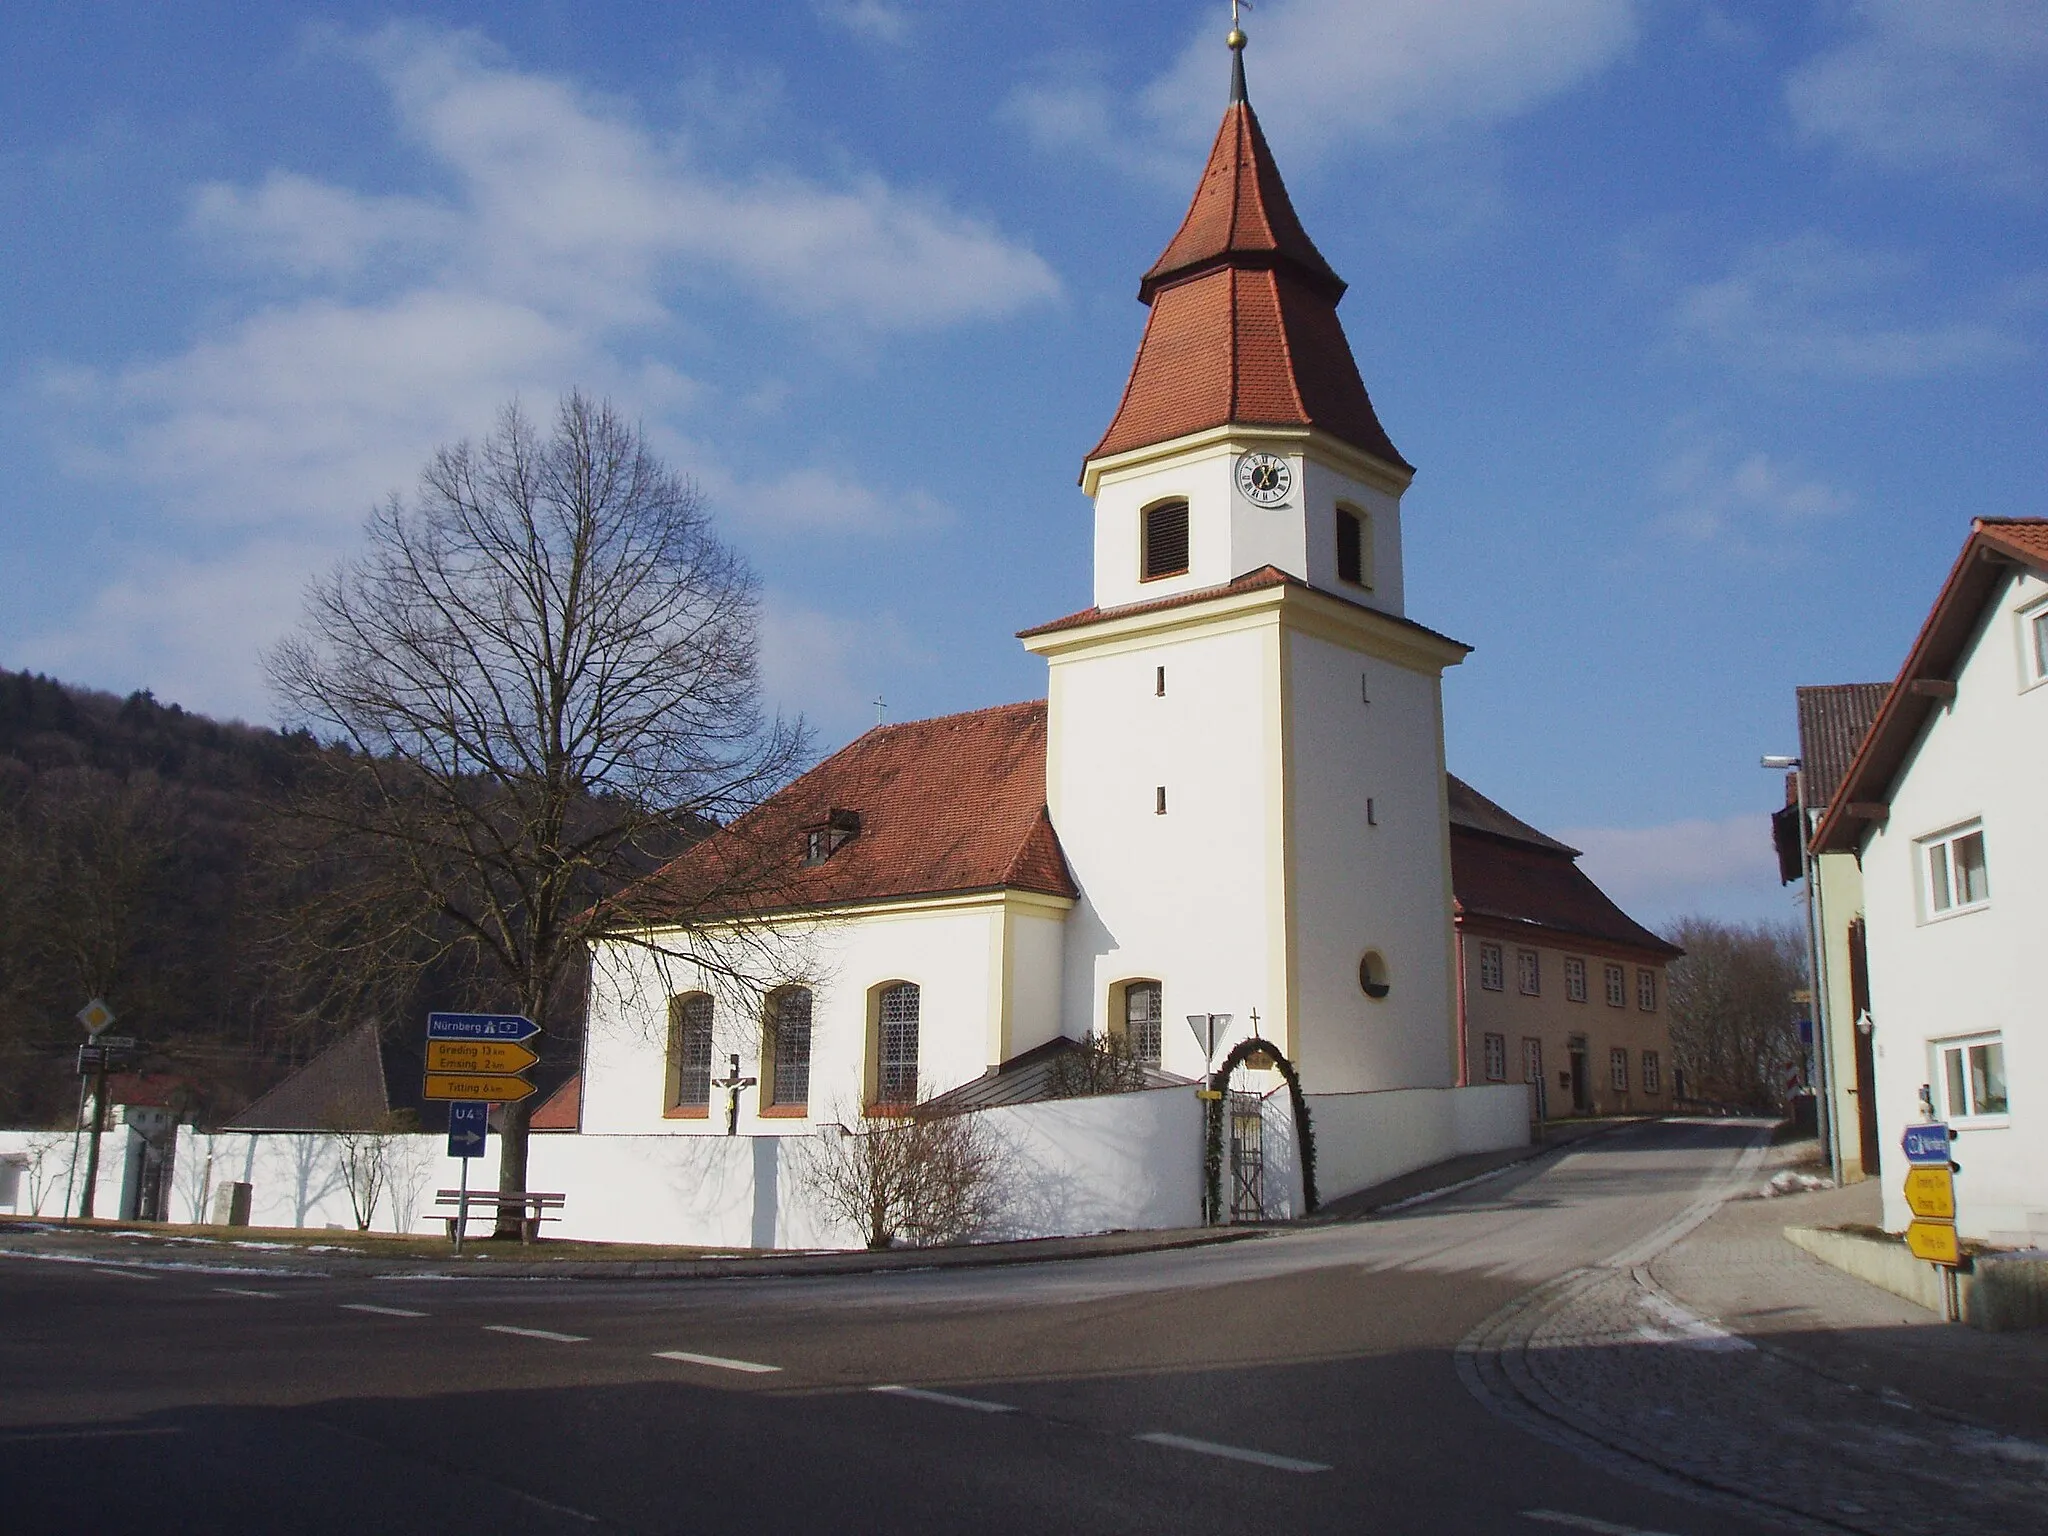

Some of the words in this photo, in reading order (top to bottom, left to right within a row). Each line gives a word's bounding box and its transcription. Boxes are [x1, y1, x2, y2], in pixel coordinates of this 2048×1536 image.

[433, 1020, 481, 1034] Nürnberg
[439, 1045, 478, 1057] Greding
[440, 1058, 477, 1070] Emsing
[484, 1059, 491, 1069] 2
[492, 1062, 505, 1070] km
[447, 1082, 480, 1094] Titting
[482, 1083, 489, 1093] 6
[491, 1085, 504, 1093] km
